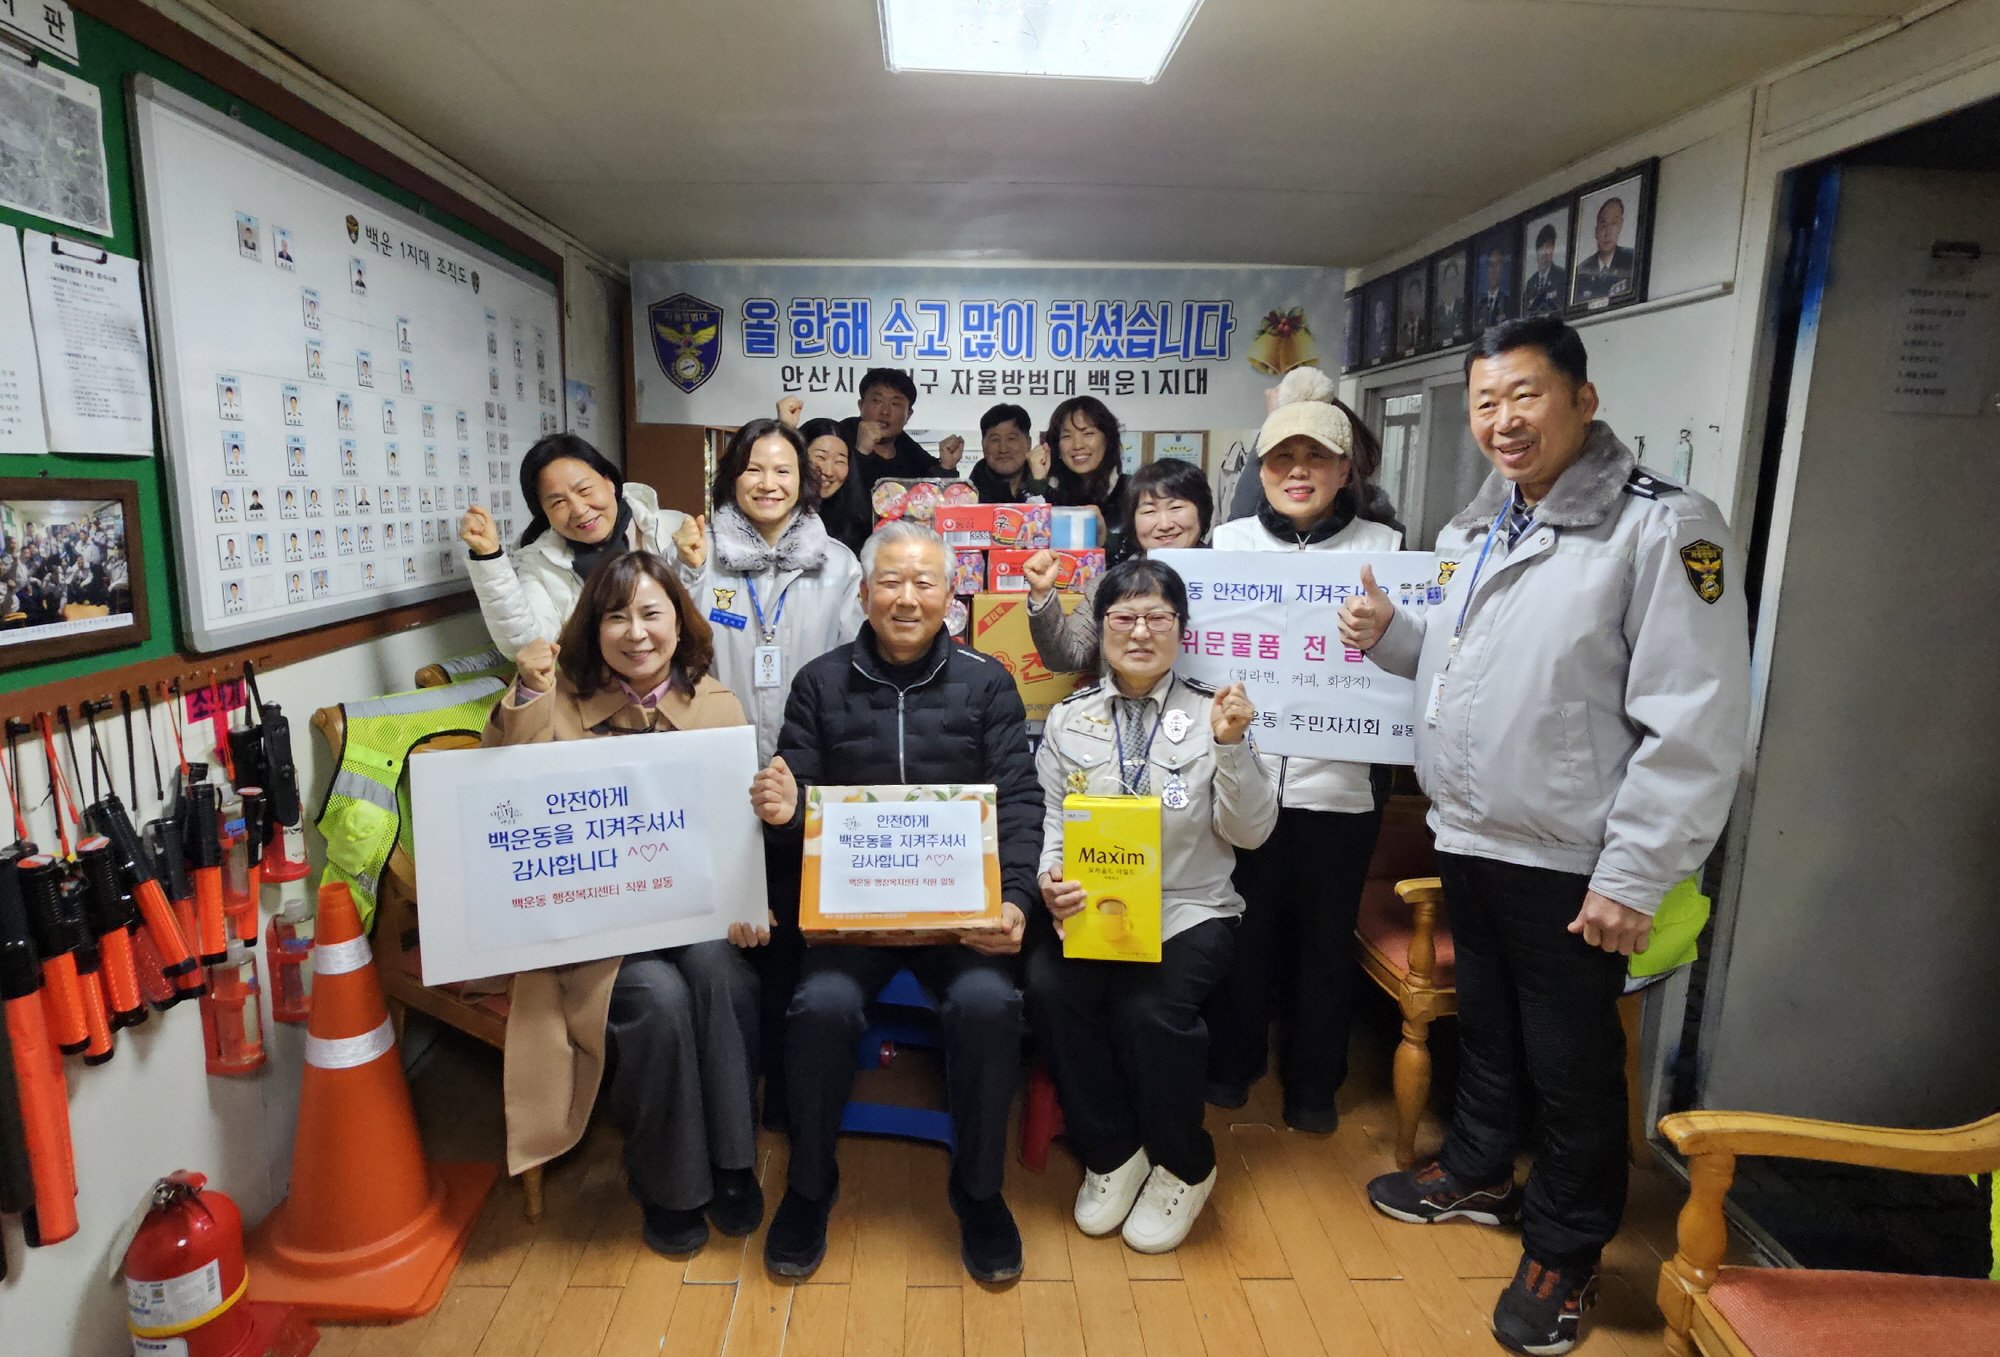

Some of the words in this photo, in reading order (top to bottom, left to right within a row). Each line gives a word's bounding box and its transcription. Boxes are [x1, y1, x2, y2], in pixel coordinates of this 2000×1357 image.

[365, 224, 393, 257] 백운
[399, 241, 431, 271] 1지대
[436, 257, 468, 284] 조직도
[742, 299, 779, 357] 올
[788, 299, 870, 358] 한해
[881, 299, 949, 359] 수고
[961, 300, 1036, 361] 많이
[1049, 300, 1234, 361] 하셨습니다
[781, 365, 854, 394] 안산시
[950, 368, 1076, 396] 자율방범대
[1088, 368, 1207, 396] 백운1지대
[1188, 581, 1204, 600] 동
[1213, 582, 1283, 604] 안전하게
[1181, 629, 1280, 661] 위문물품
[1291, 673, 1320, 688] 커피,
[1327, 674, 1371, 690] 화장지)
[1251, 710, 1277, 728] 운동
[1289, 714, 1380, 736] 주민자치회
[1391, 724, 1414, 737] 일동
[546, 786, 629, 815] 안전하게
[488, 823, 574, 852] 백운동을
[585, 809, 685, 840] 지켜주셔서
[877, 814, 930, 828] 안전하게
[839, 834, 892, 849] 백운동을
[899, 834, 966, 848] 지켜주셔서
[512, 848, 618, 882] 감사합니다
[851, 854, 919, 869] 감사합니다
[1078, 845, 1145, 866] Maxim
[849, 878, 871, 887] 백운동
[874, 878, 919, 886] 행정복지센터
[922, 878, 937, 886] 직원
[940, 878, 955, 886] 일동
[1088, 867, 1113, 875] 모카골드
[1116, 868, 1136, 876] 마일드
[511, 894, 547, 909] 백운동
[552, 884, 620, 905] 행정복지센터
[625, 880, 647, 893] 직원
[652, 876, 674, 890] 일동
